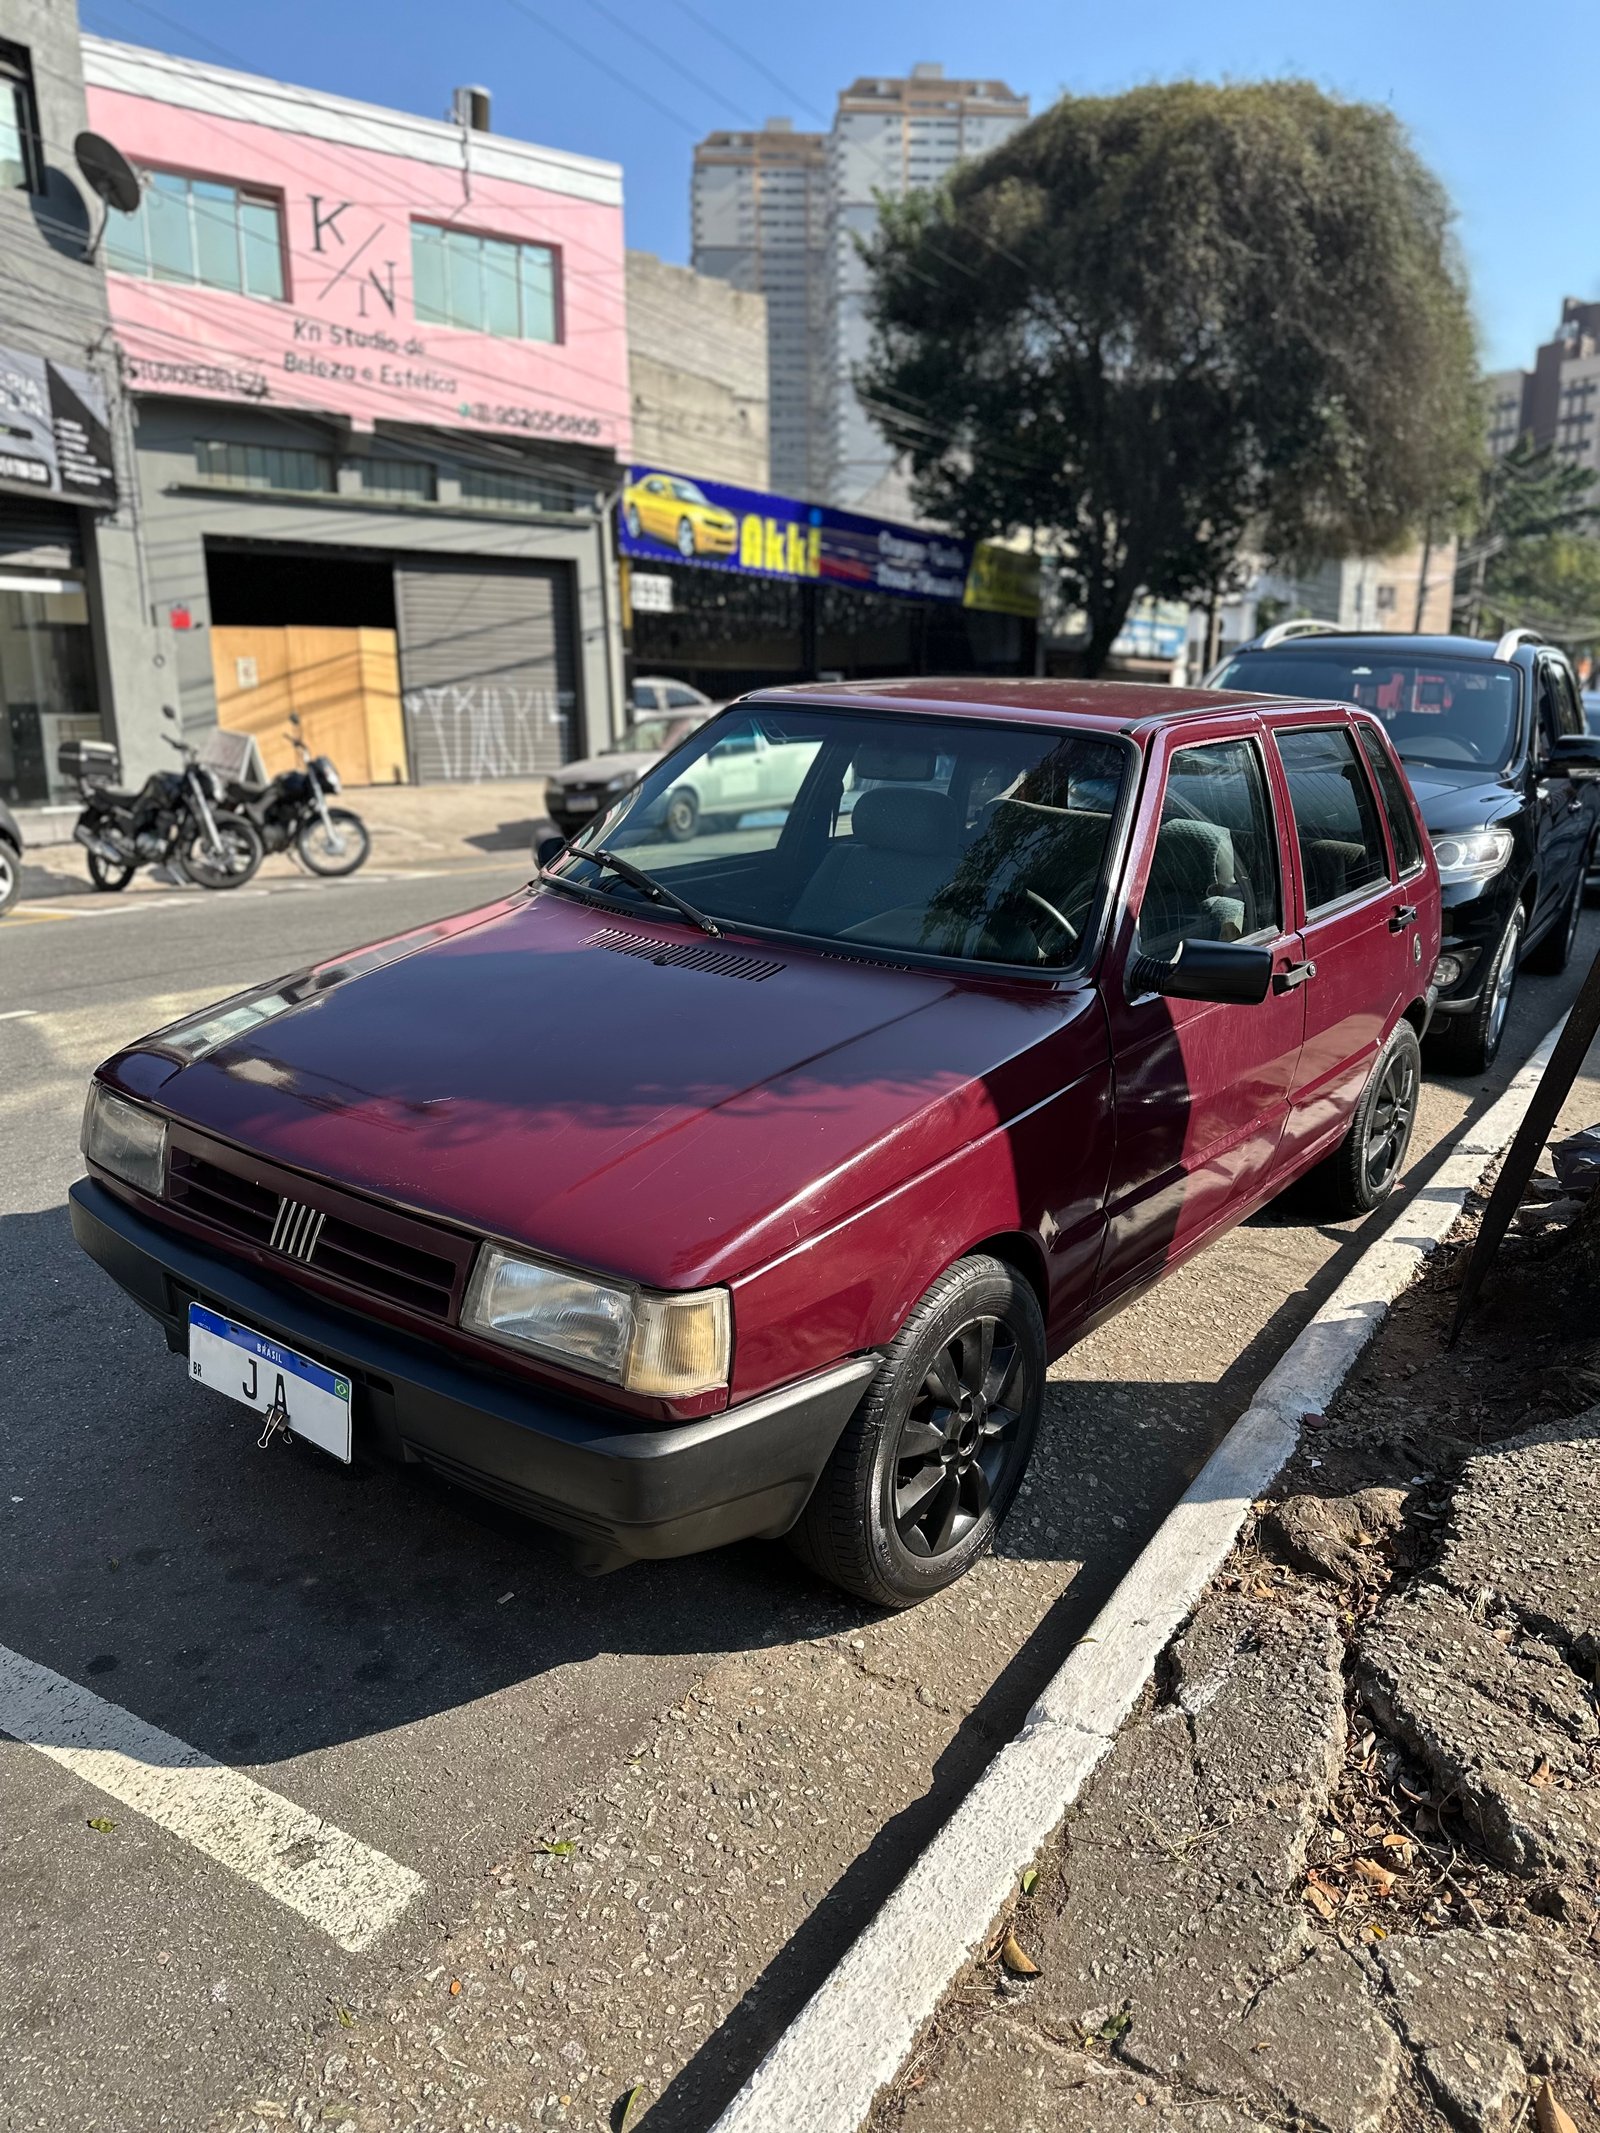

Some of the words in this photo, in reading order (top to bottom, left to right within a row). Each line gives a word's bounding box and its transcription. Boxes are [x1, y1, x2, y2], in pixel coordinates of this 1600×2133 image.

[306, 194, 353, 254] K
[357, 260, 397, 318] N
[293, 319, 322, 342] Kn
[330, 324, 399, 354] Studio
[283, 351, 356, 380] Beleza
[256, 1343, 283, 1363] BRASIL
[192, 1361, 202, 1378] BR
